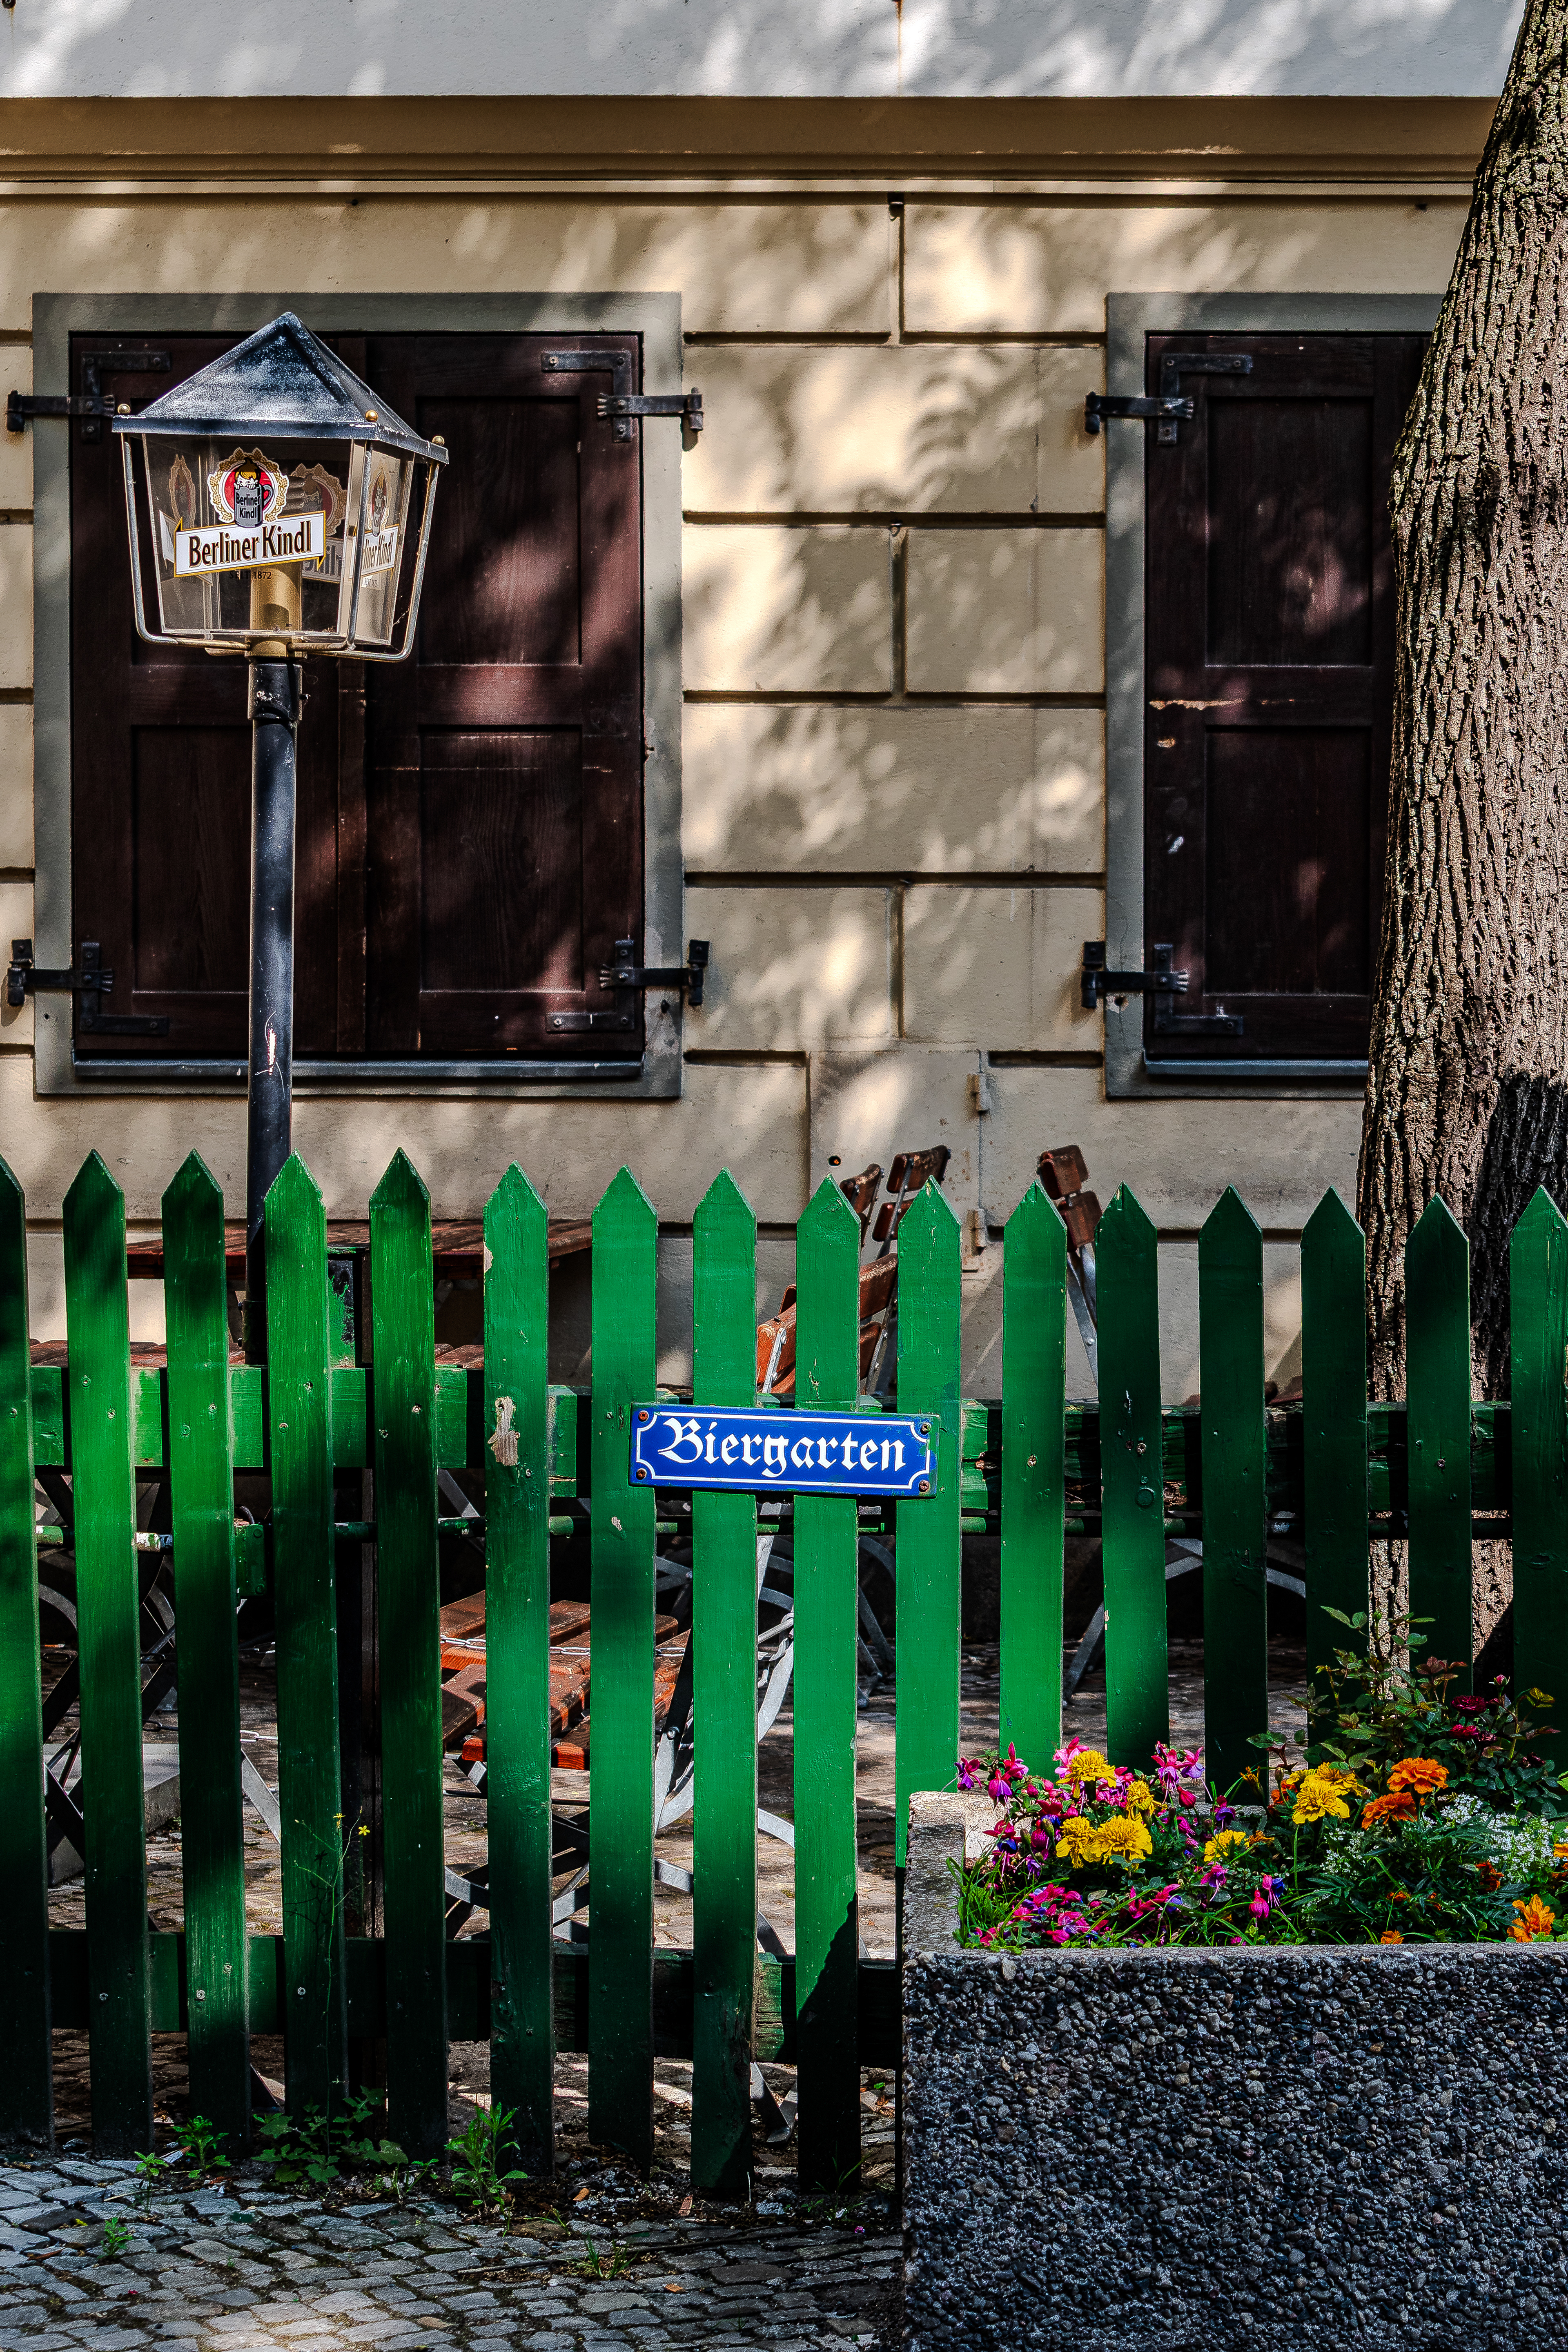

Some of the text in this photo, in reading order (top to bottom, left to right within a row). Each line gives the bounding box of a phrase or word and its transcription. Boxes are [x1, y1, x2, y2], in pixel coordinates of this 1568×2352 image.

[236, 492, 261, 506] Berliner
[239, 507, 257, 519] Kindl
[189, 532, 259, 568] Berliner
[262, 520, 312, 558] Kindl
[229, 571, 272, 579] SEIT 1872
[657, 1417, 906, 1478] Biergarten
